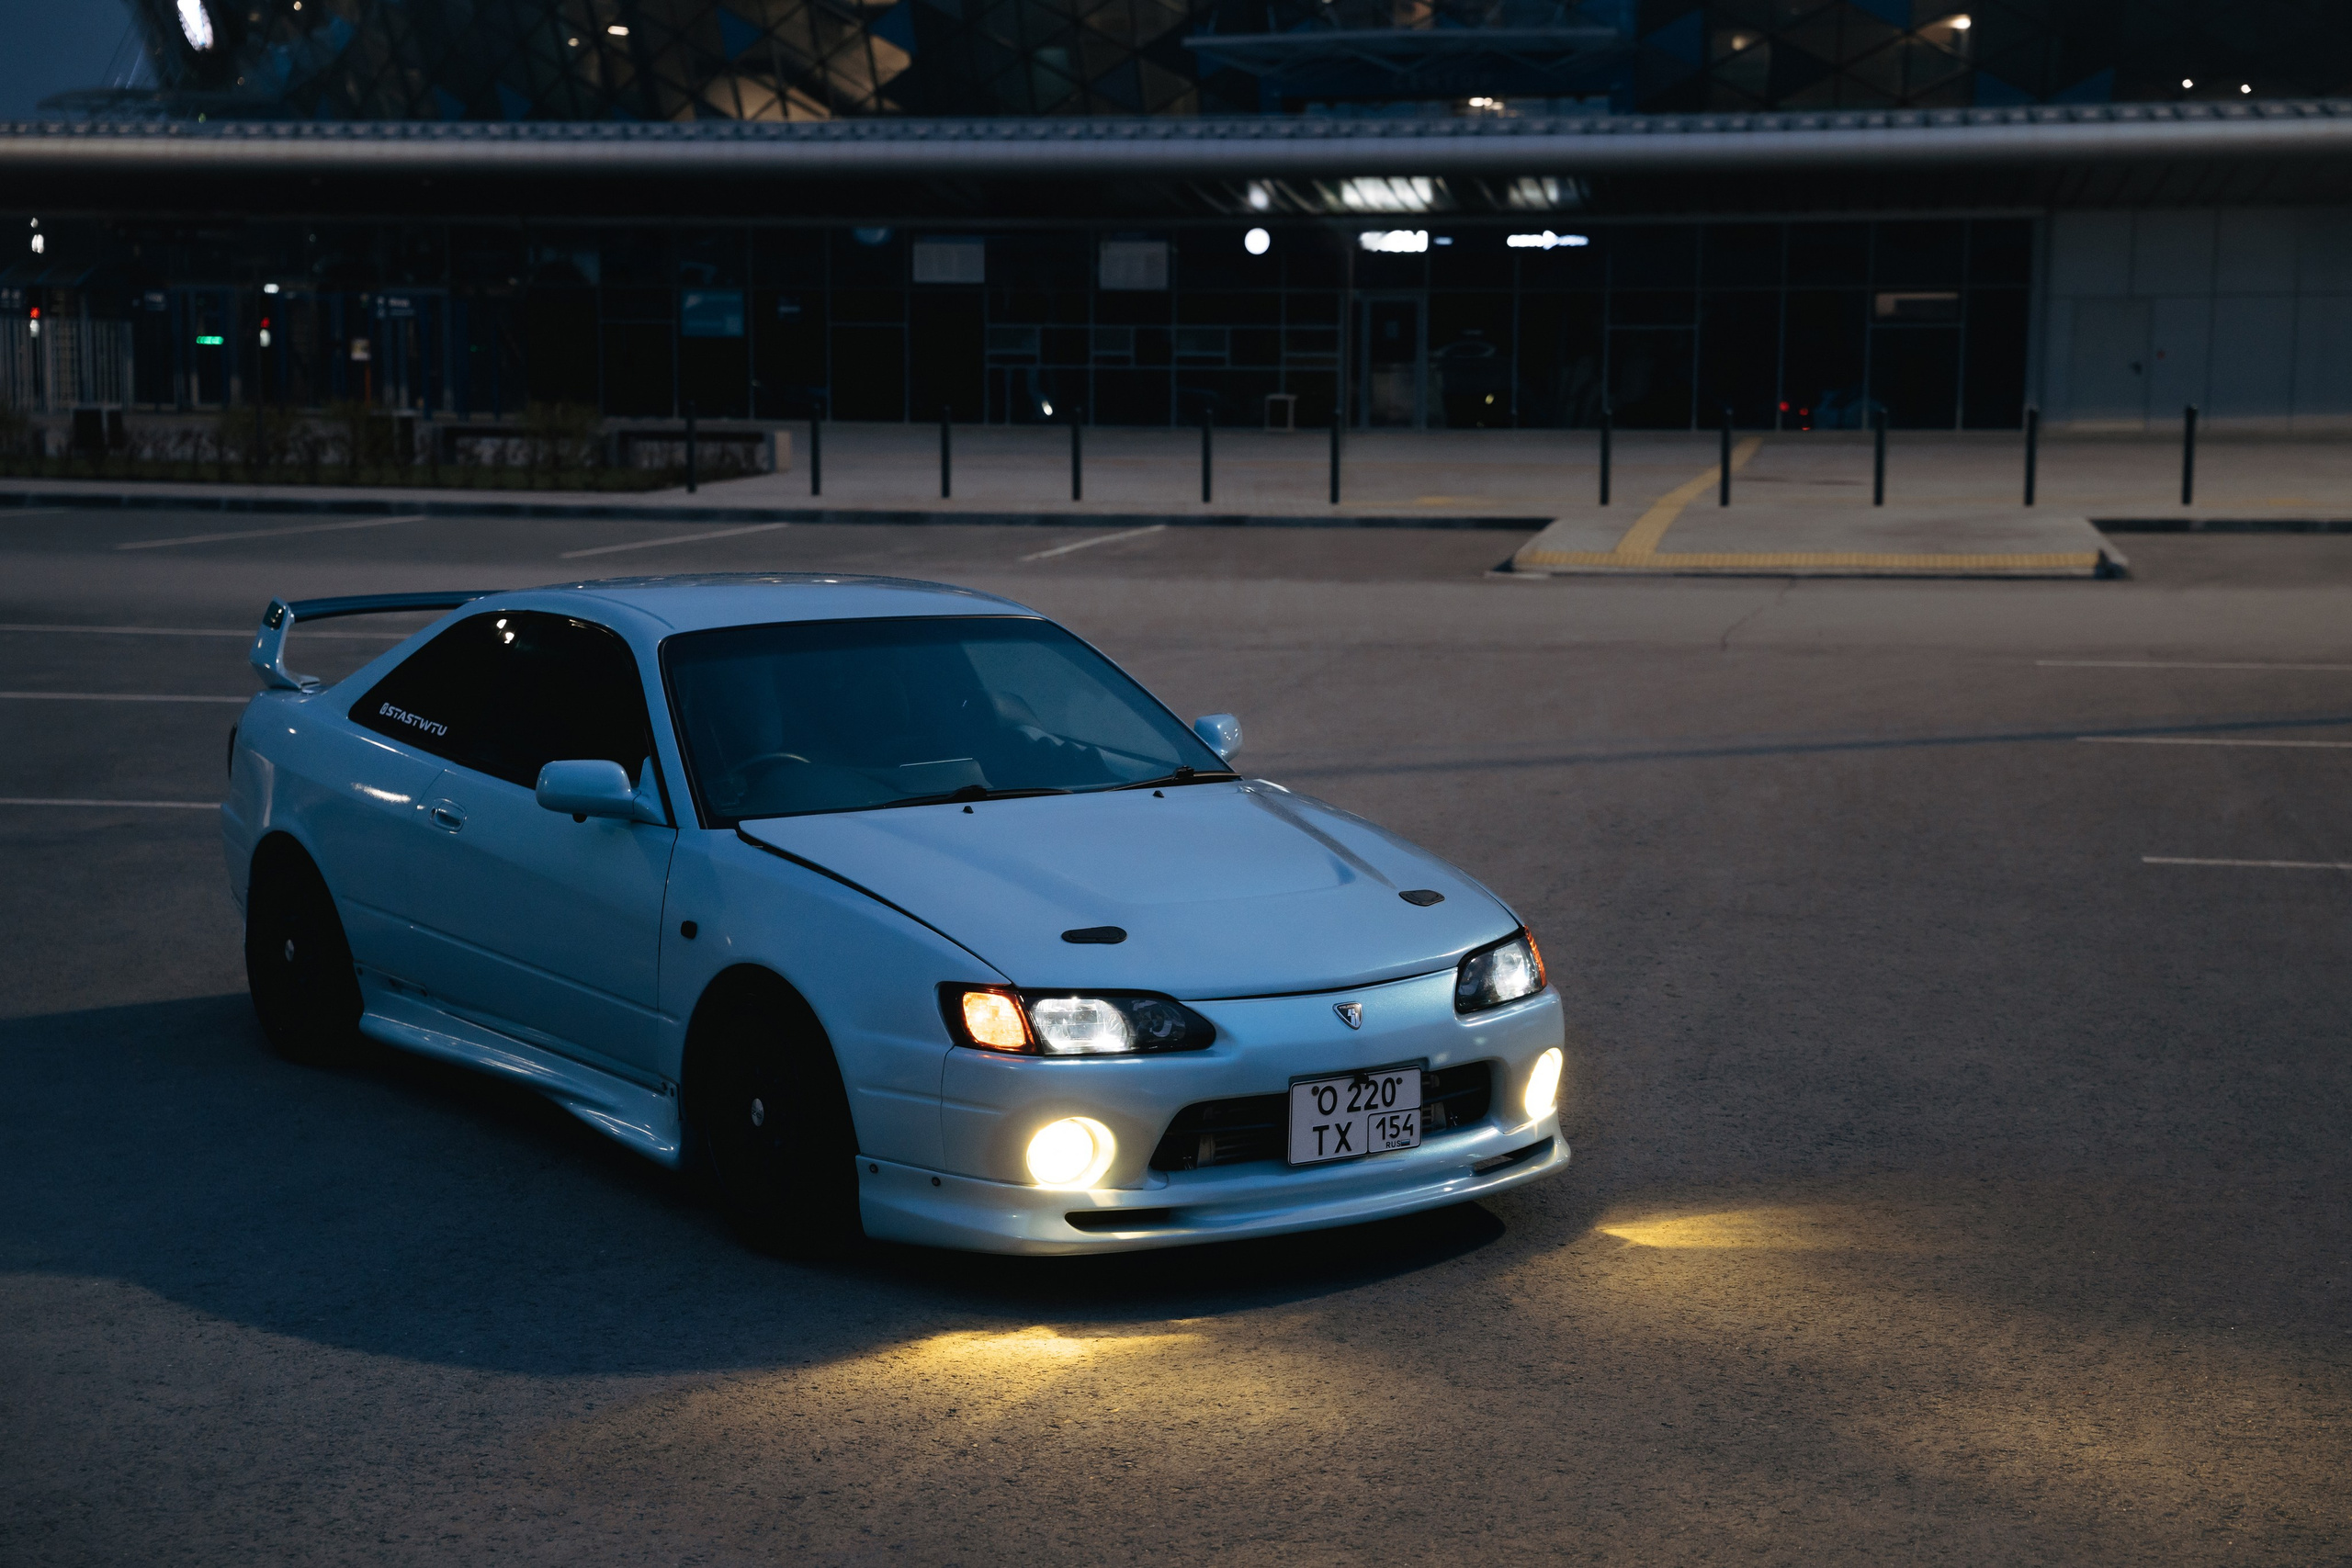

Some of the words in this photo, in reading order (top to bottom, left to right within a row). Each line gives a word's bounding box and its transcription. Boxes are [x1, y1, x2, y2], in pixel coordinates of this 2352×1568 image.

[1312, 1122, 1352, 1156] TX
[1375, 1113, 1414, 1140] 154
[1385, 1140, 1401, 1148] RUS
